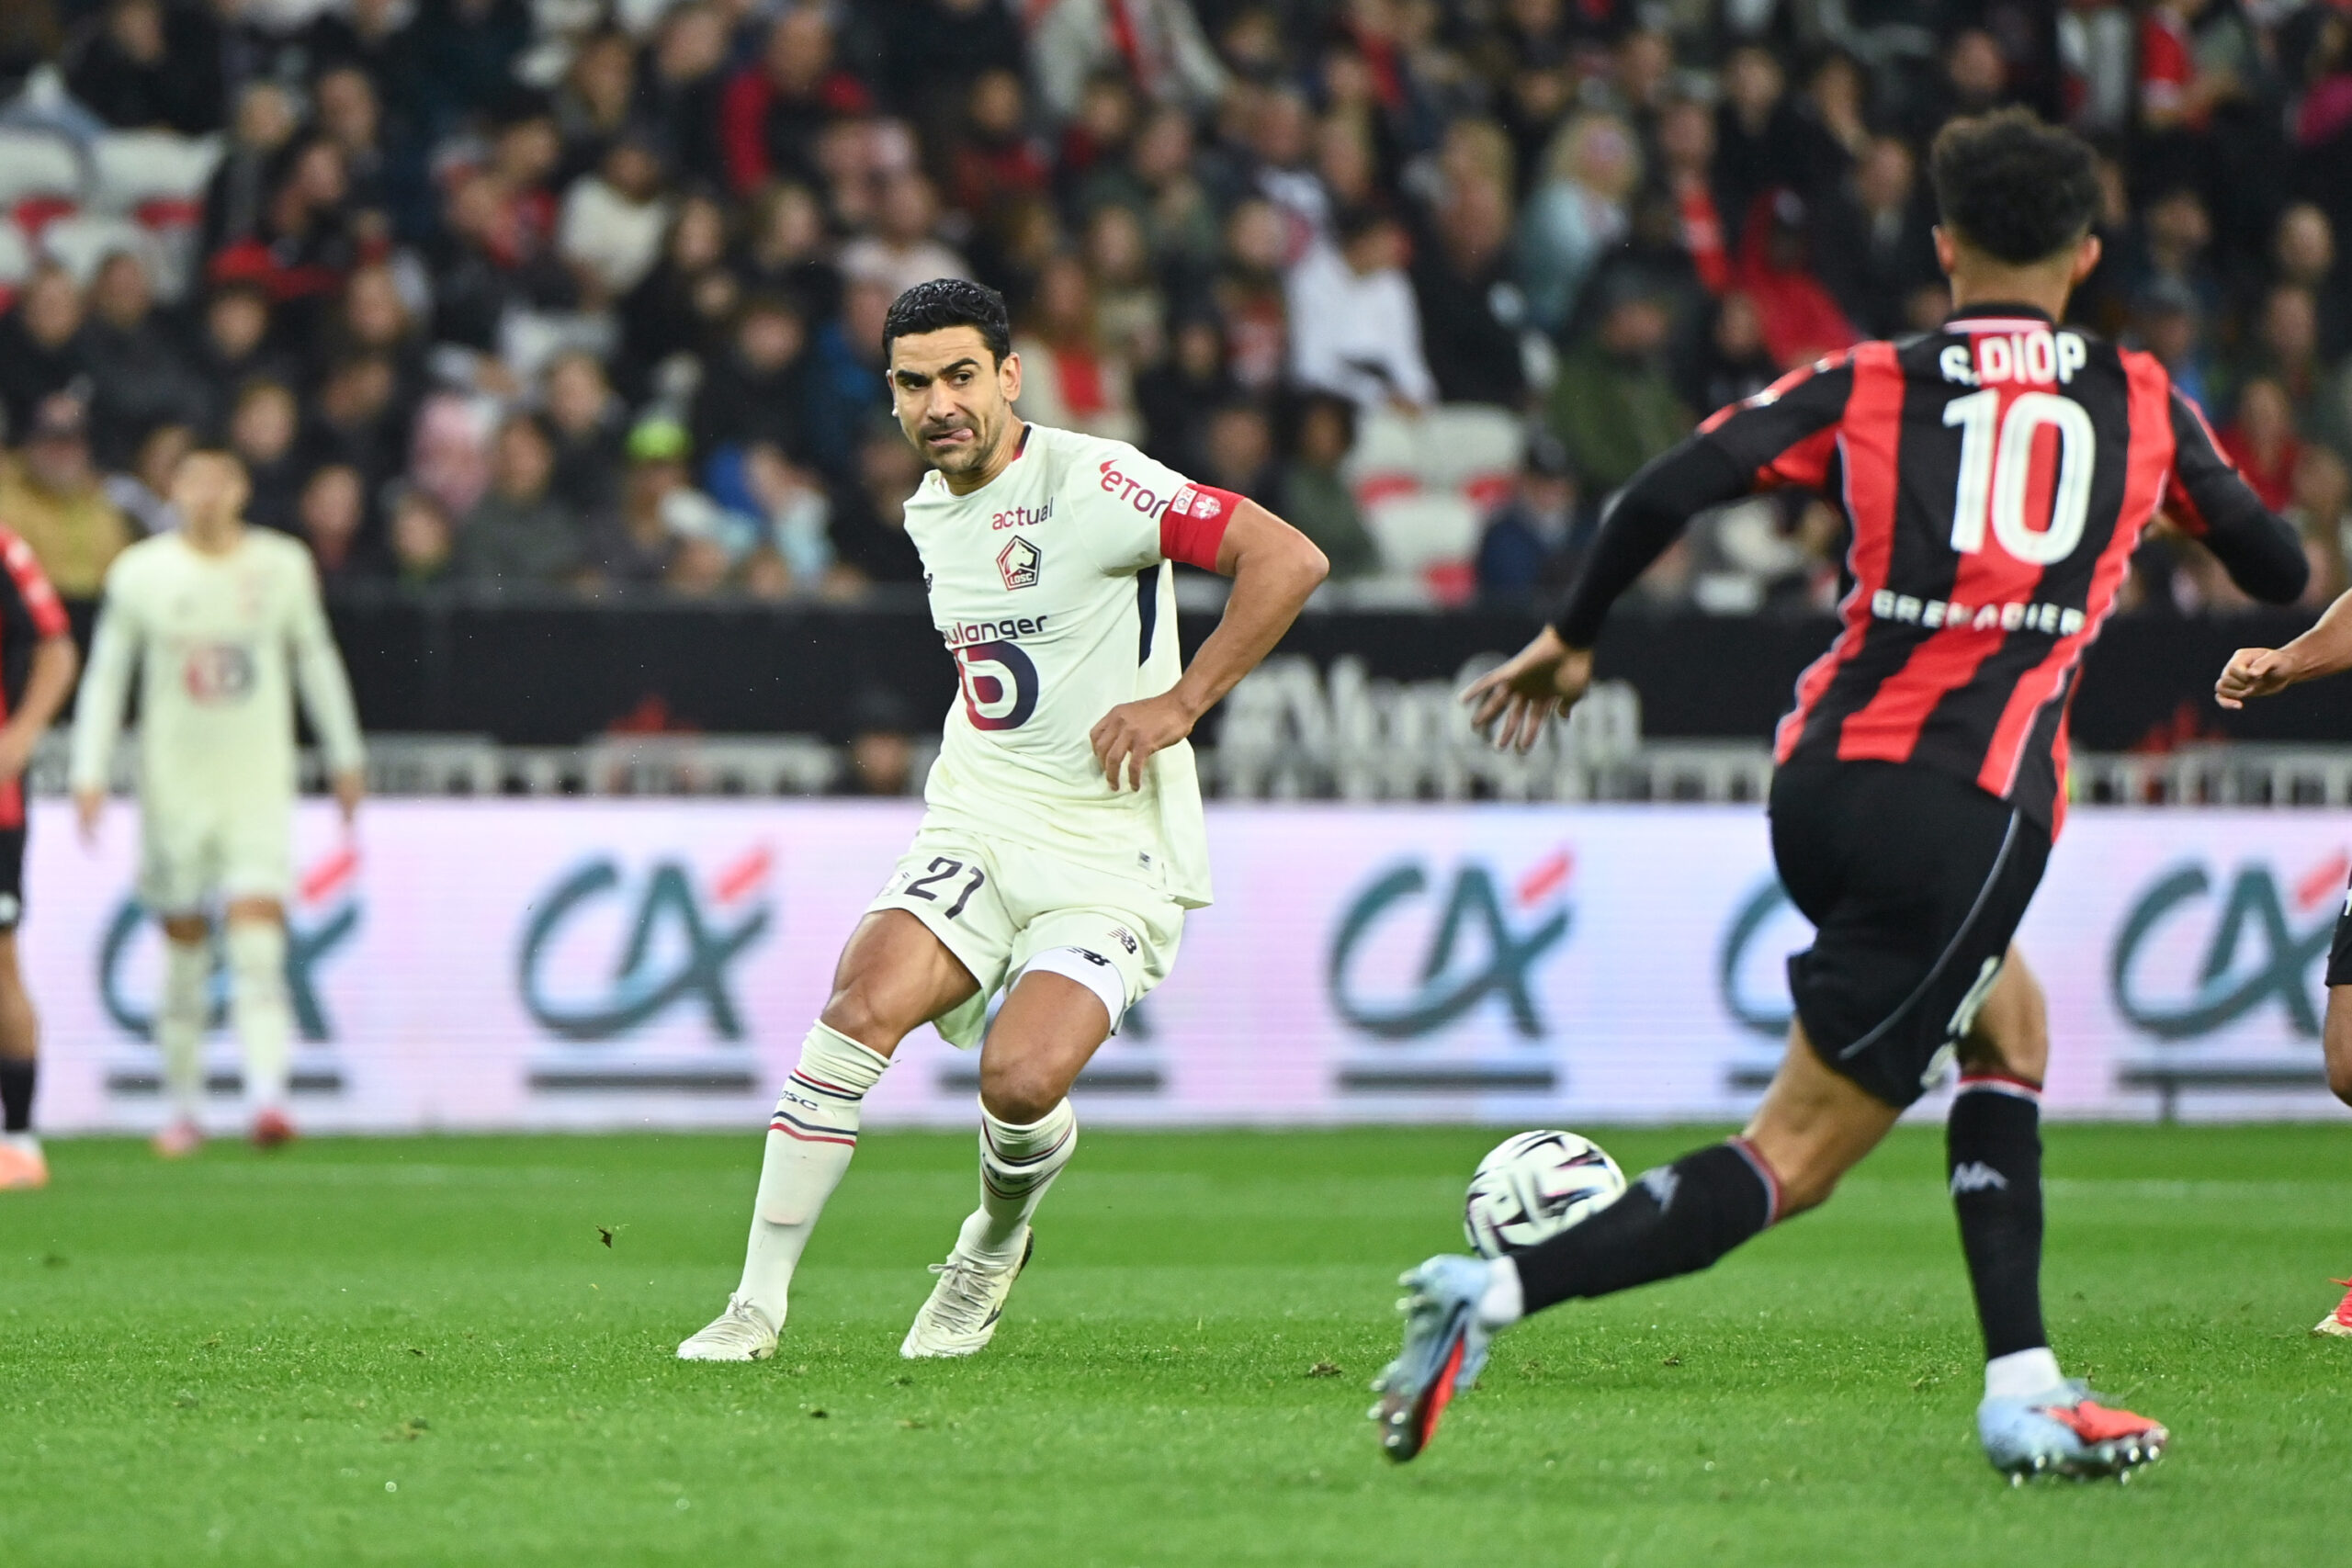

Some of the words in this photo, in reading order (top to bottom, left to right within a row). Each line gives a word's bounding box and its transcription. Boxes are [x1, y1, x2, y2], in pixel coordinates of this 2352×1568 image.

[1101, 470, 1170, 519] eTor
[1942, 388, 2096, 565] 10
[992, 496, 1054, 530] actual
[1010, 572, 1034, 585] LOSC
[943, 615, 1047, 645] ulanger
[1871, 588, 2086, 637] GRENADIER
[903, 856, 985, 919] 21
